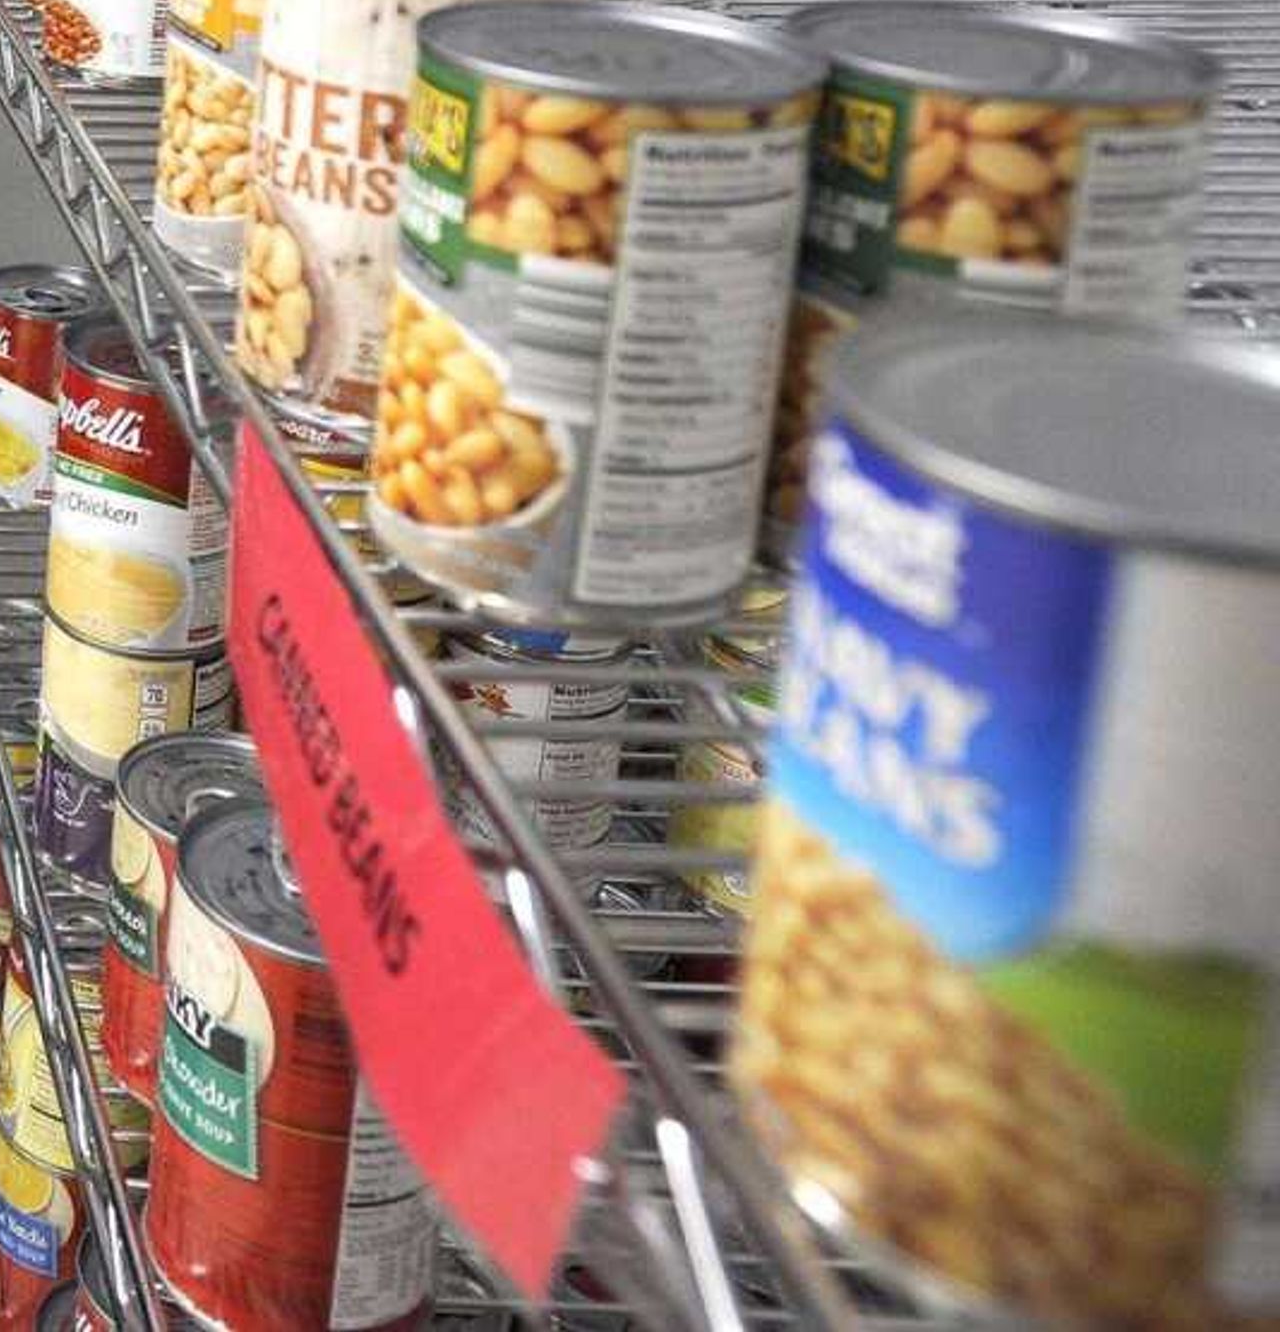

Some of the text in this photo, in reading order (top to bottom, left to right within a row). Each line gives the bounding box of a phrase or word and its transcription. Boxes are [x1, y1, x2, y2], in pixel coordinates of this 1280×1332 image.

[260, 58, 409, 164] TER
[257, 130, 398, 216] BEANS
[61, 398, 147, 455] pbell's
[68, 489, 139, 526] Chicken
[259, 593, 343, 787] CANNED
[328, 774, 421, 977] BEANS
